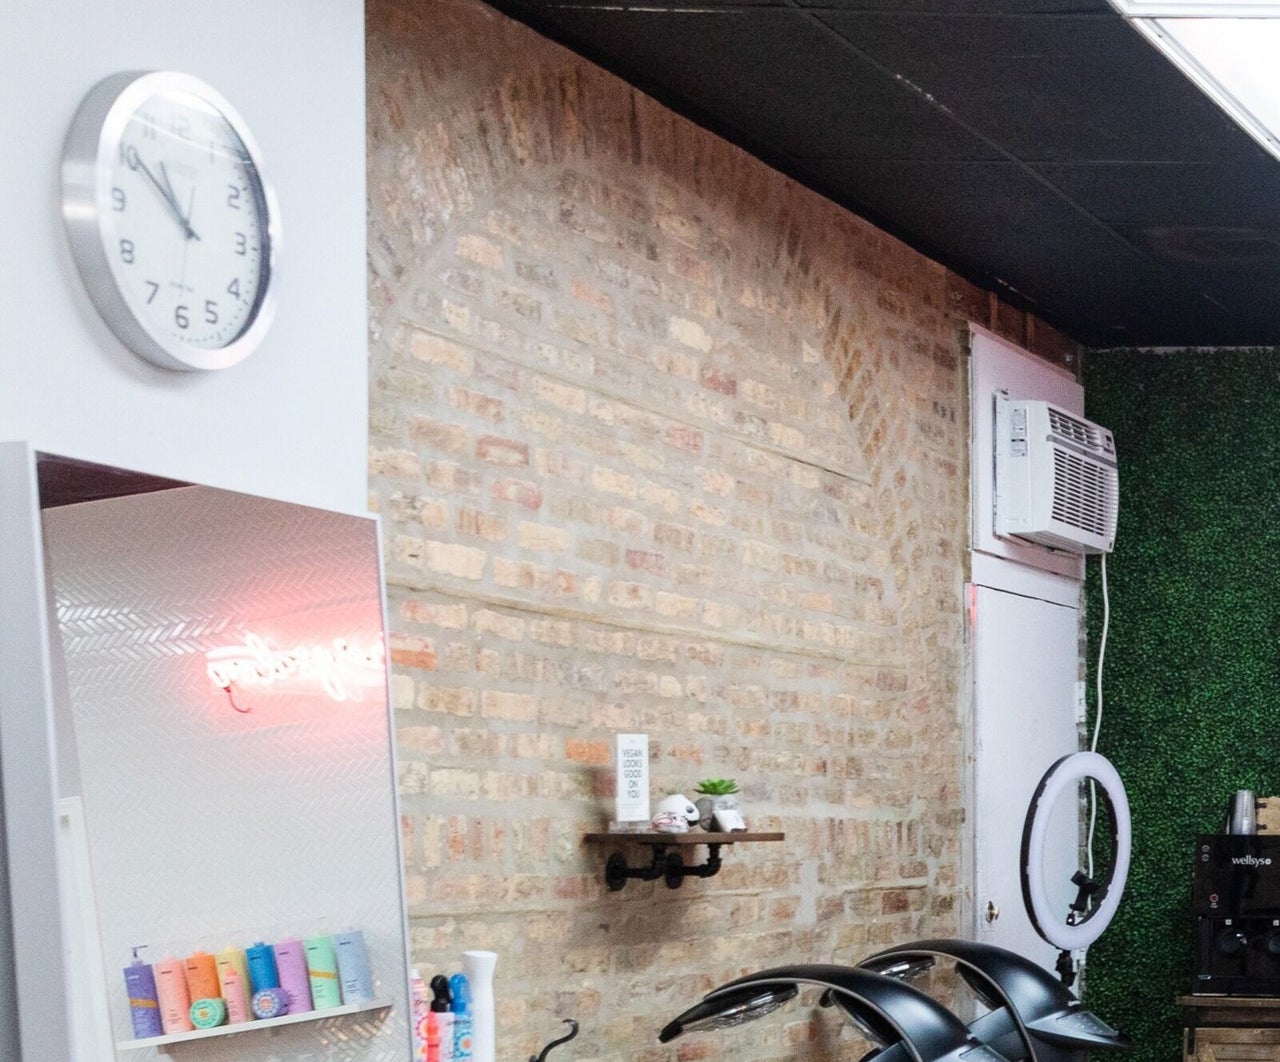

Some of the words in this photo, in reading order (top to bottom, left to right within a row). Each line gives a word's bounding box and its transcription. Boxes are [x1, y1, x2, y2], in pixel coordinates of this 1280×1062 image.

[119, 142, 139, 171] 10
[112, 187, 126, 212] 9
[228, 184, 240, 209] 2
[120, 239, 135, 264] 8
[235, 232, 247, 256] 3
[145, 281, 159, 304] 7
[227, 278, 241, 300] 4
[175, 305, 190, 329] 6
[204, 300, 219, 325] 5
[623, 748, 643, 758] VEGAN
[623, 759, 642, 768] LOOKS
[623, 769, 642, 779] GOOD
[628, 780, 639, 789] ON
[627, 789, 641, 799] YOU
